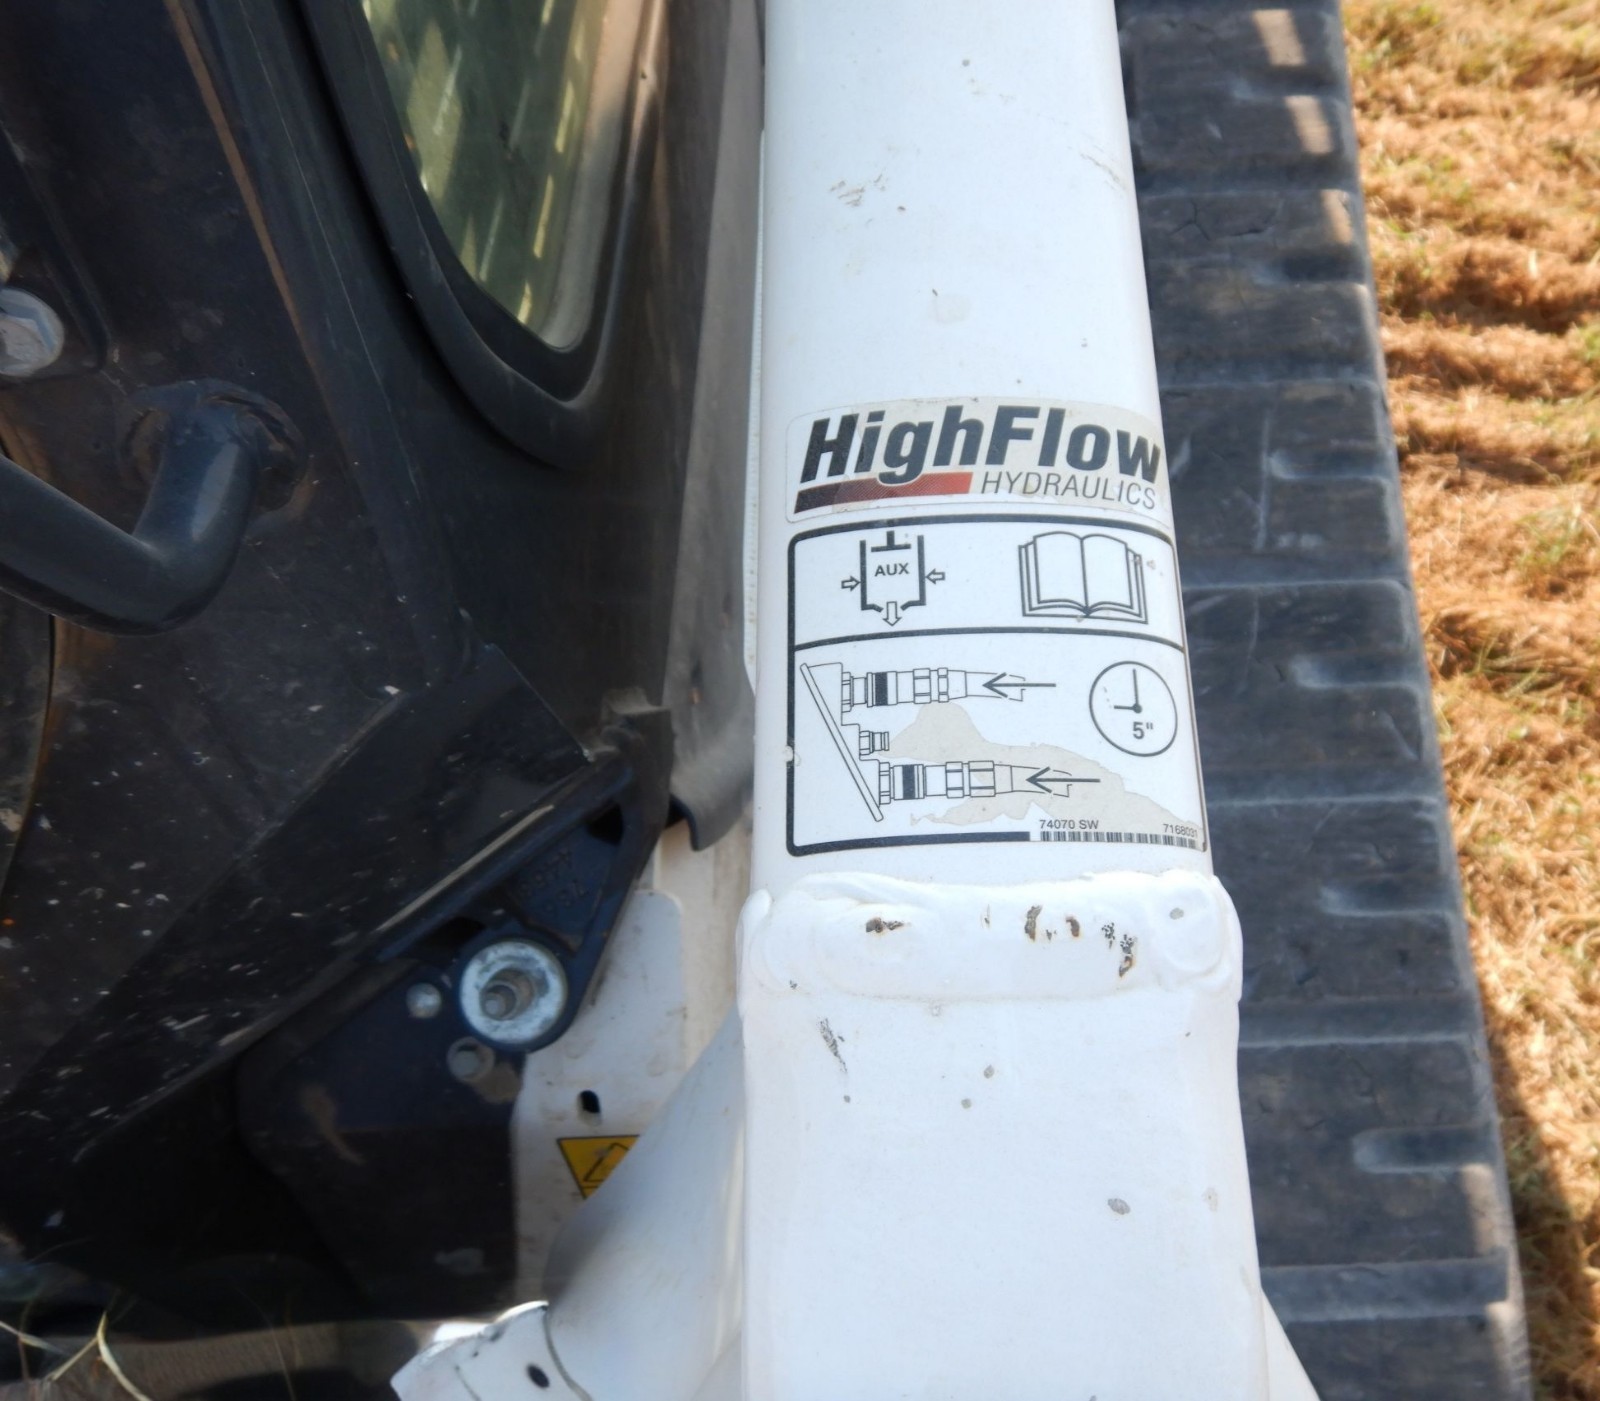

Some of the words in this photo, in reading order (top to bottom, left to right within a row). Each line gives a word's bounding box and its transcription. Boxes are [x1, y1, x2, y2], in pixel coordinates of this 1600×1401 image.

[799, 405, 1162, 485] HighFlow
[981, 471, 1156, 510] HYDRAULICS
[874, 562, 910, 578] AUX
[1039, 819, 1076, 830] 74070
[1078, 819, 1099, 830] SW
